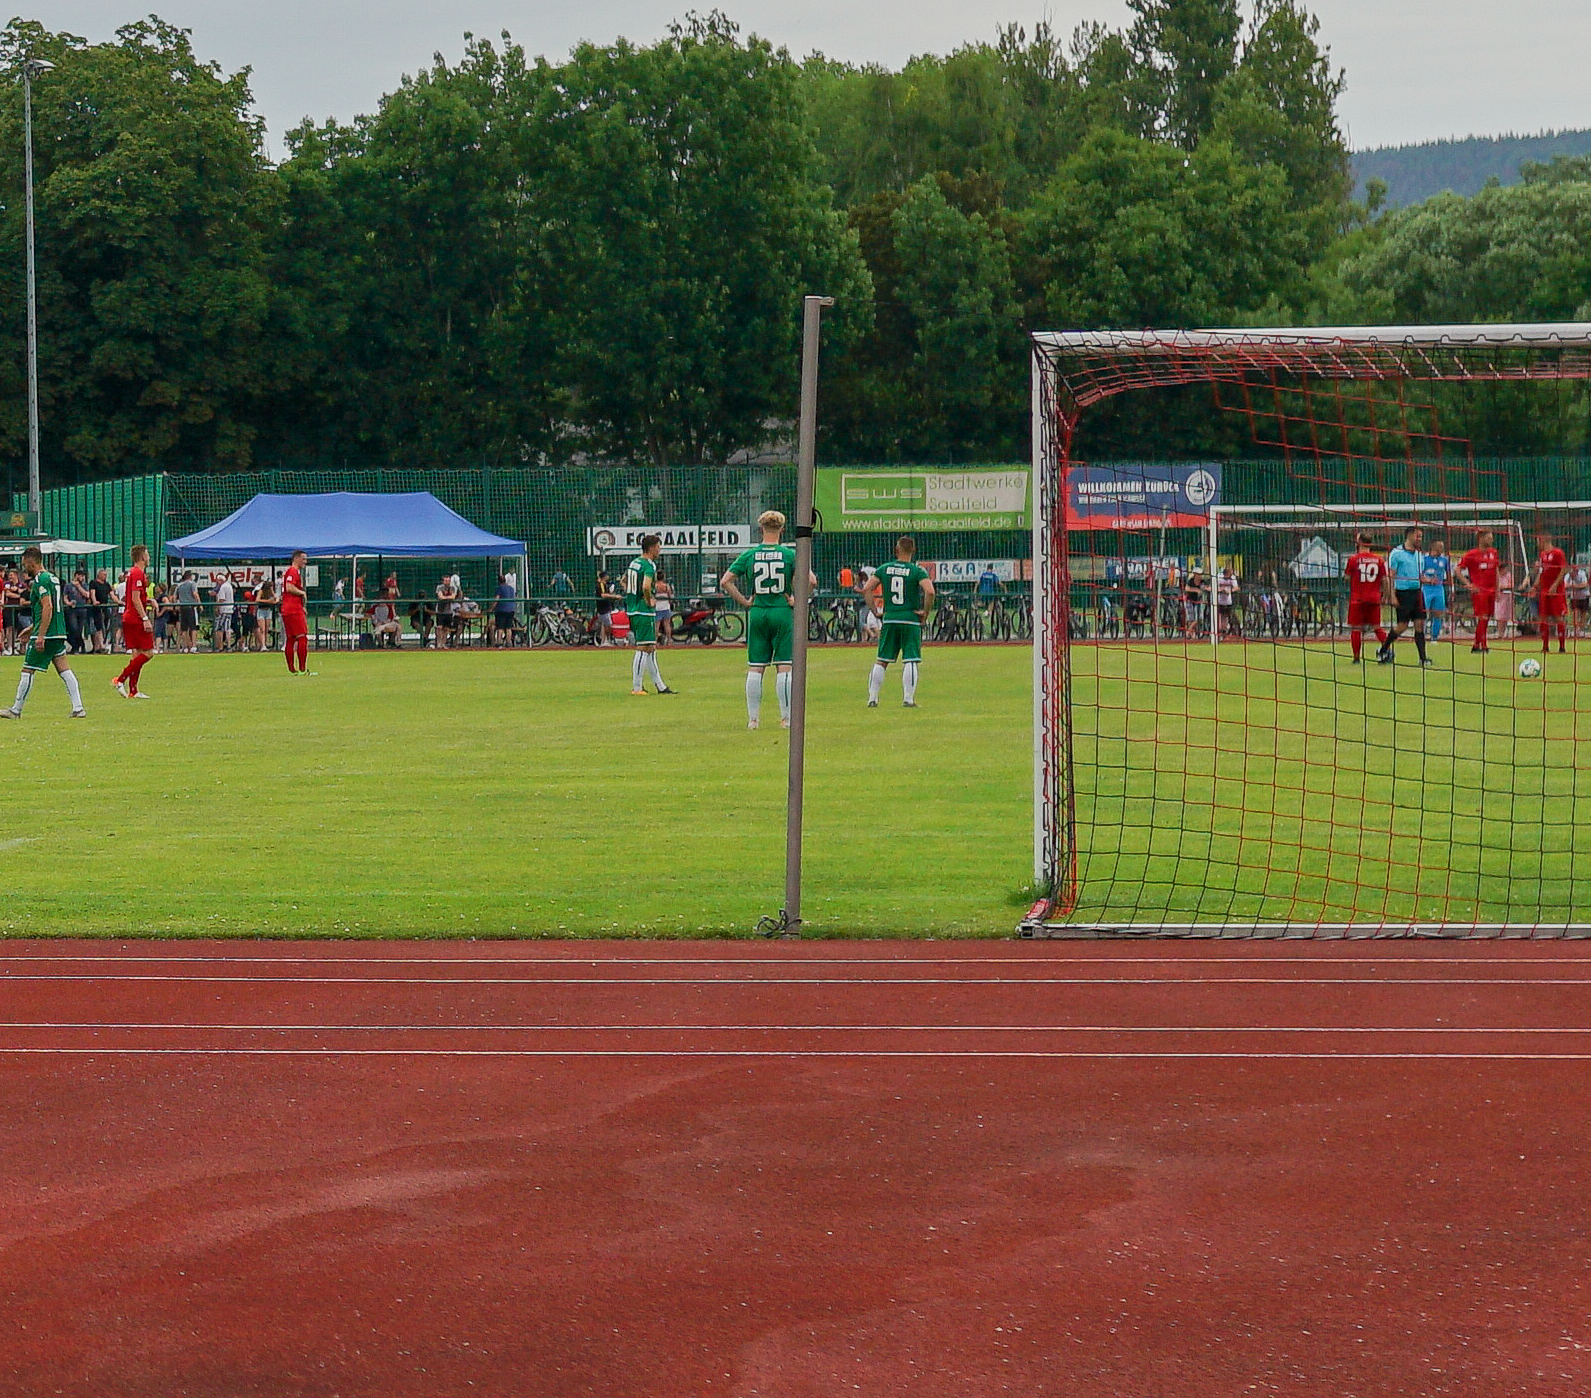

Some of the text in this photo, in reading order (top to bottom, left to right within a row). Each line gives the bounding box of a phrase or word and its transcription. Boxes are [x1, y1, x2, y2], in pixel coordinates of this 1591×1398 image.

[929, 476, 1023, 490] Stadtwerke
[929, 496, 997, 511] Saalfeld
[841, 516, 1012, 530] www.stadtwerke-saalfeld.de
[658, 531, 740, 546] SAALFELD
[753, 562, 785, 594] 25
[1359, 563, 1379, 583] 10
[891, 576, 904, 605] 9
